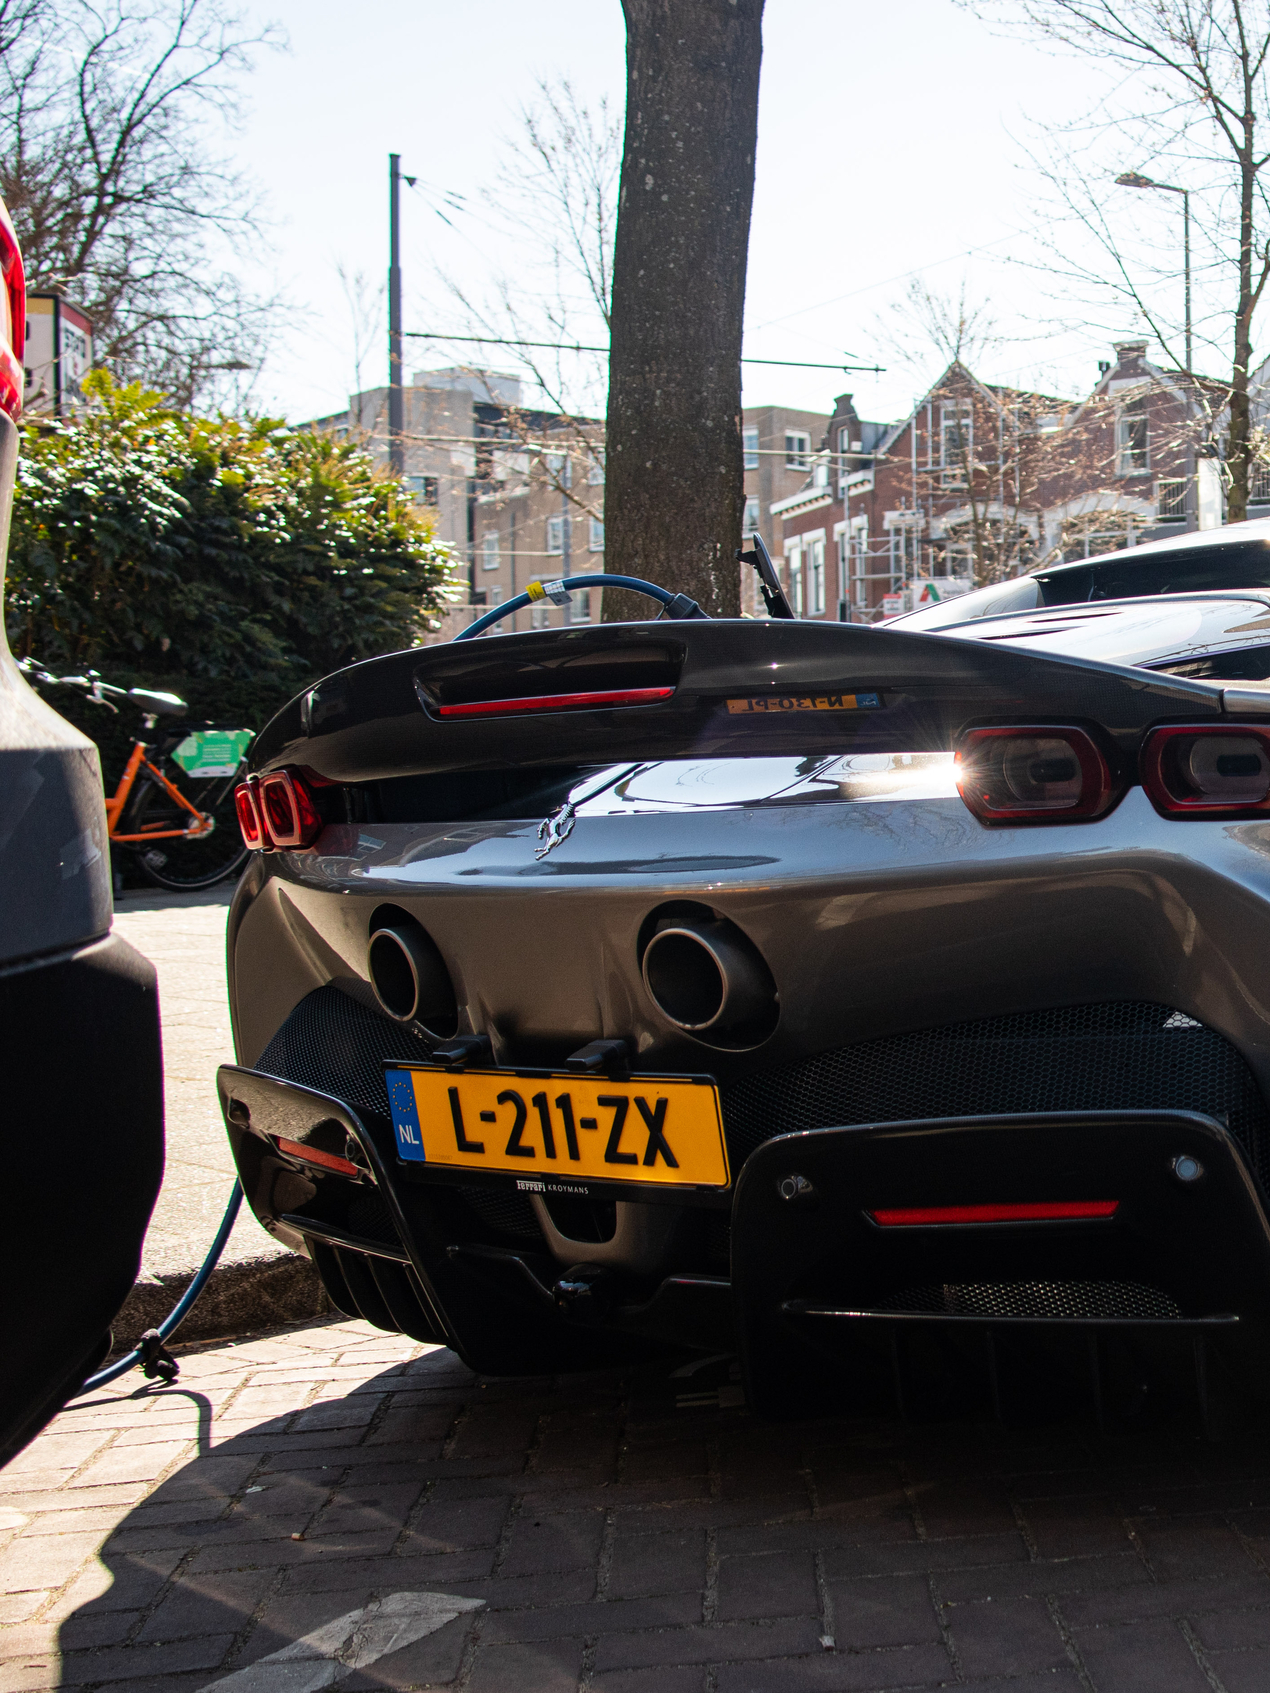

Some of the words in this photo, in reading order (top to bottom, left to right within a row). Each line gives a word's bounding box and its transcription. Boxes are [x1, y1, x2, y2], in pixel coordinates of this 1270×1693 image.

[398, 1124, 420, 1145] NL
[447, 1086, 680, 1168] L-211-ZX
[516, 1180, 546, 1192] Ferrari
[547, 1184, 589, 1195] KROYMANS
